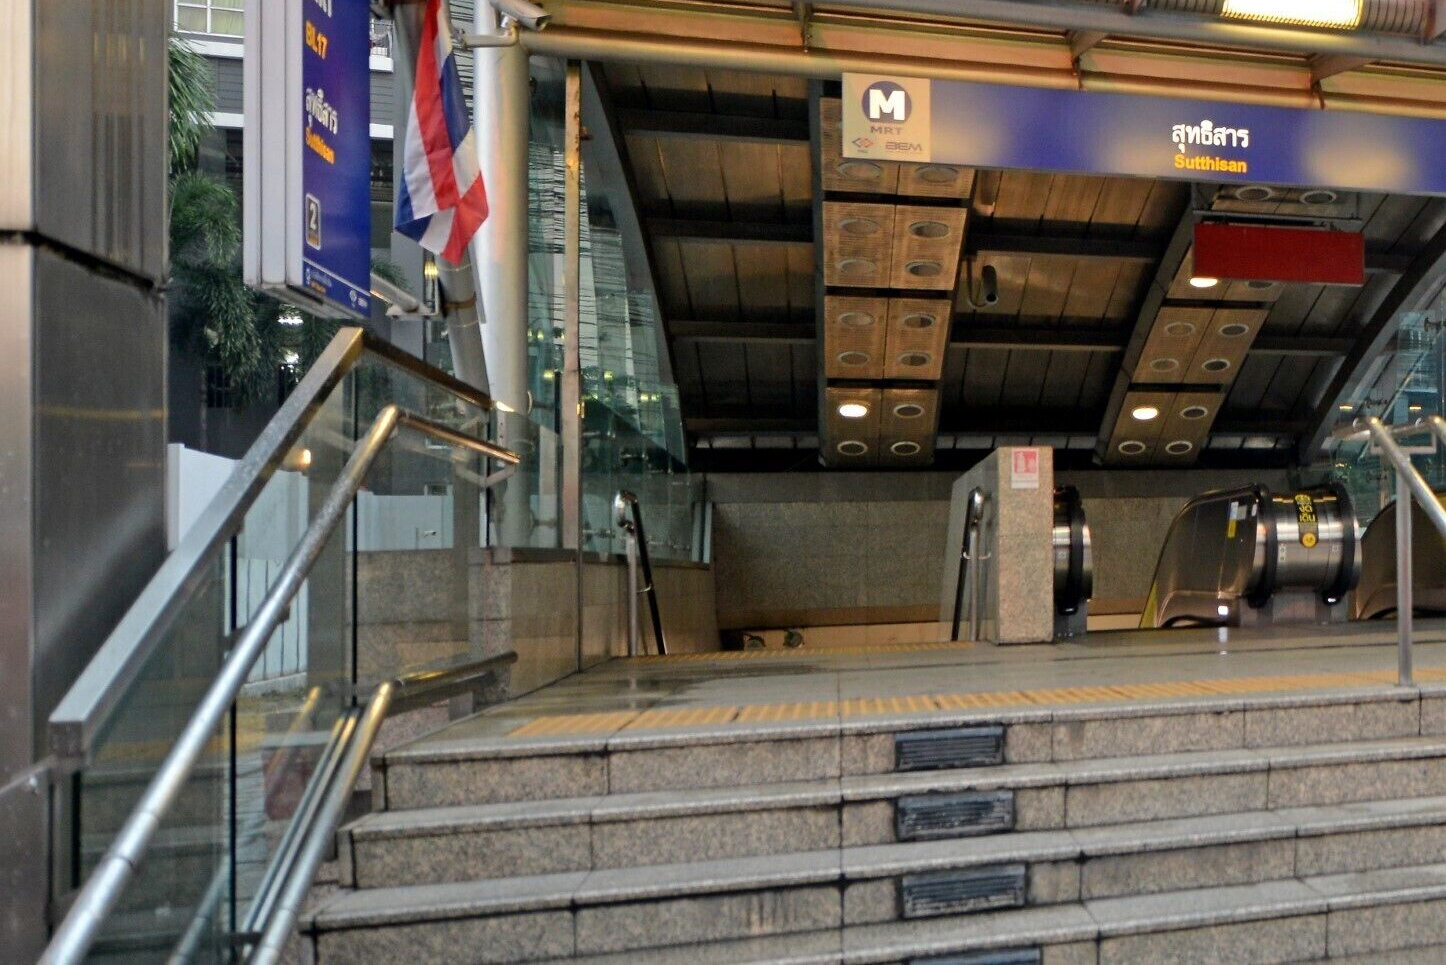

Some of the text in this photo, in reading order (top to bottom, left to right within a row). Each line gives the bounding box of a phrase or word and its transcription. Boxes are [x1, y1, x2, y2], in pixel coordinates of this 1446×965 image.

[305, 20, 328, 60] BL17
[870, 125, 904, 136] MRT
[1171, 119, 1250, 154] สุทธิสาร
[1174, 153, 1248, 173] Sutthisan
[309, 202, 317, 230] 2
